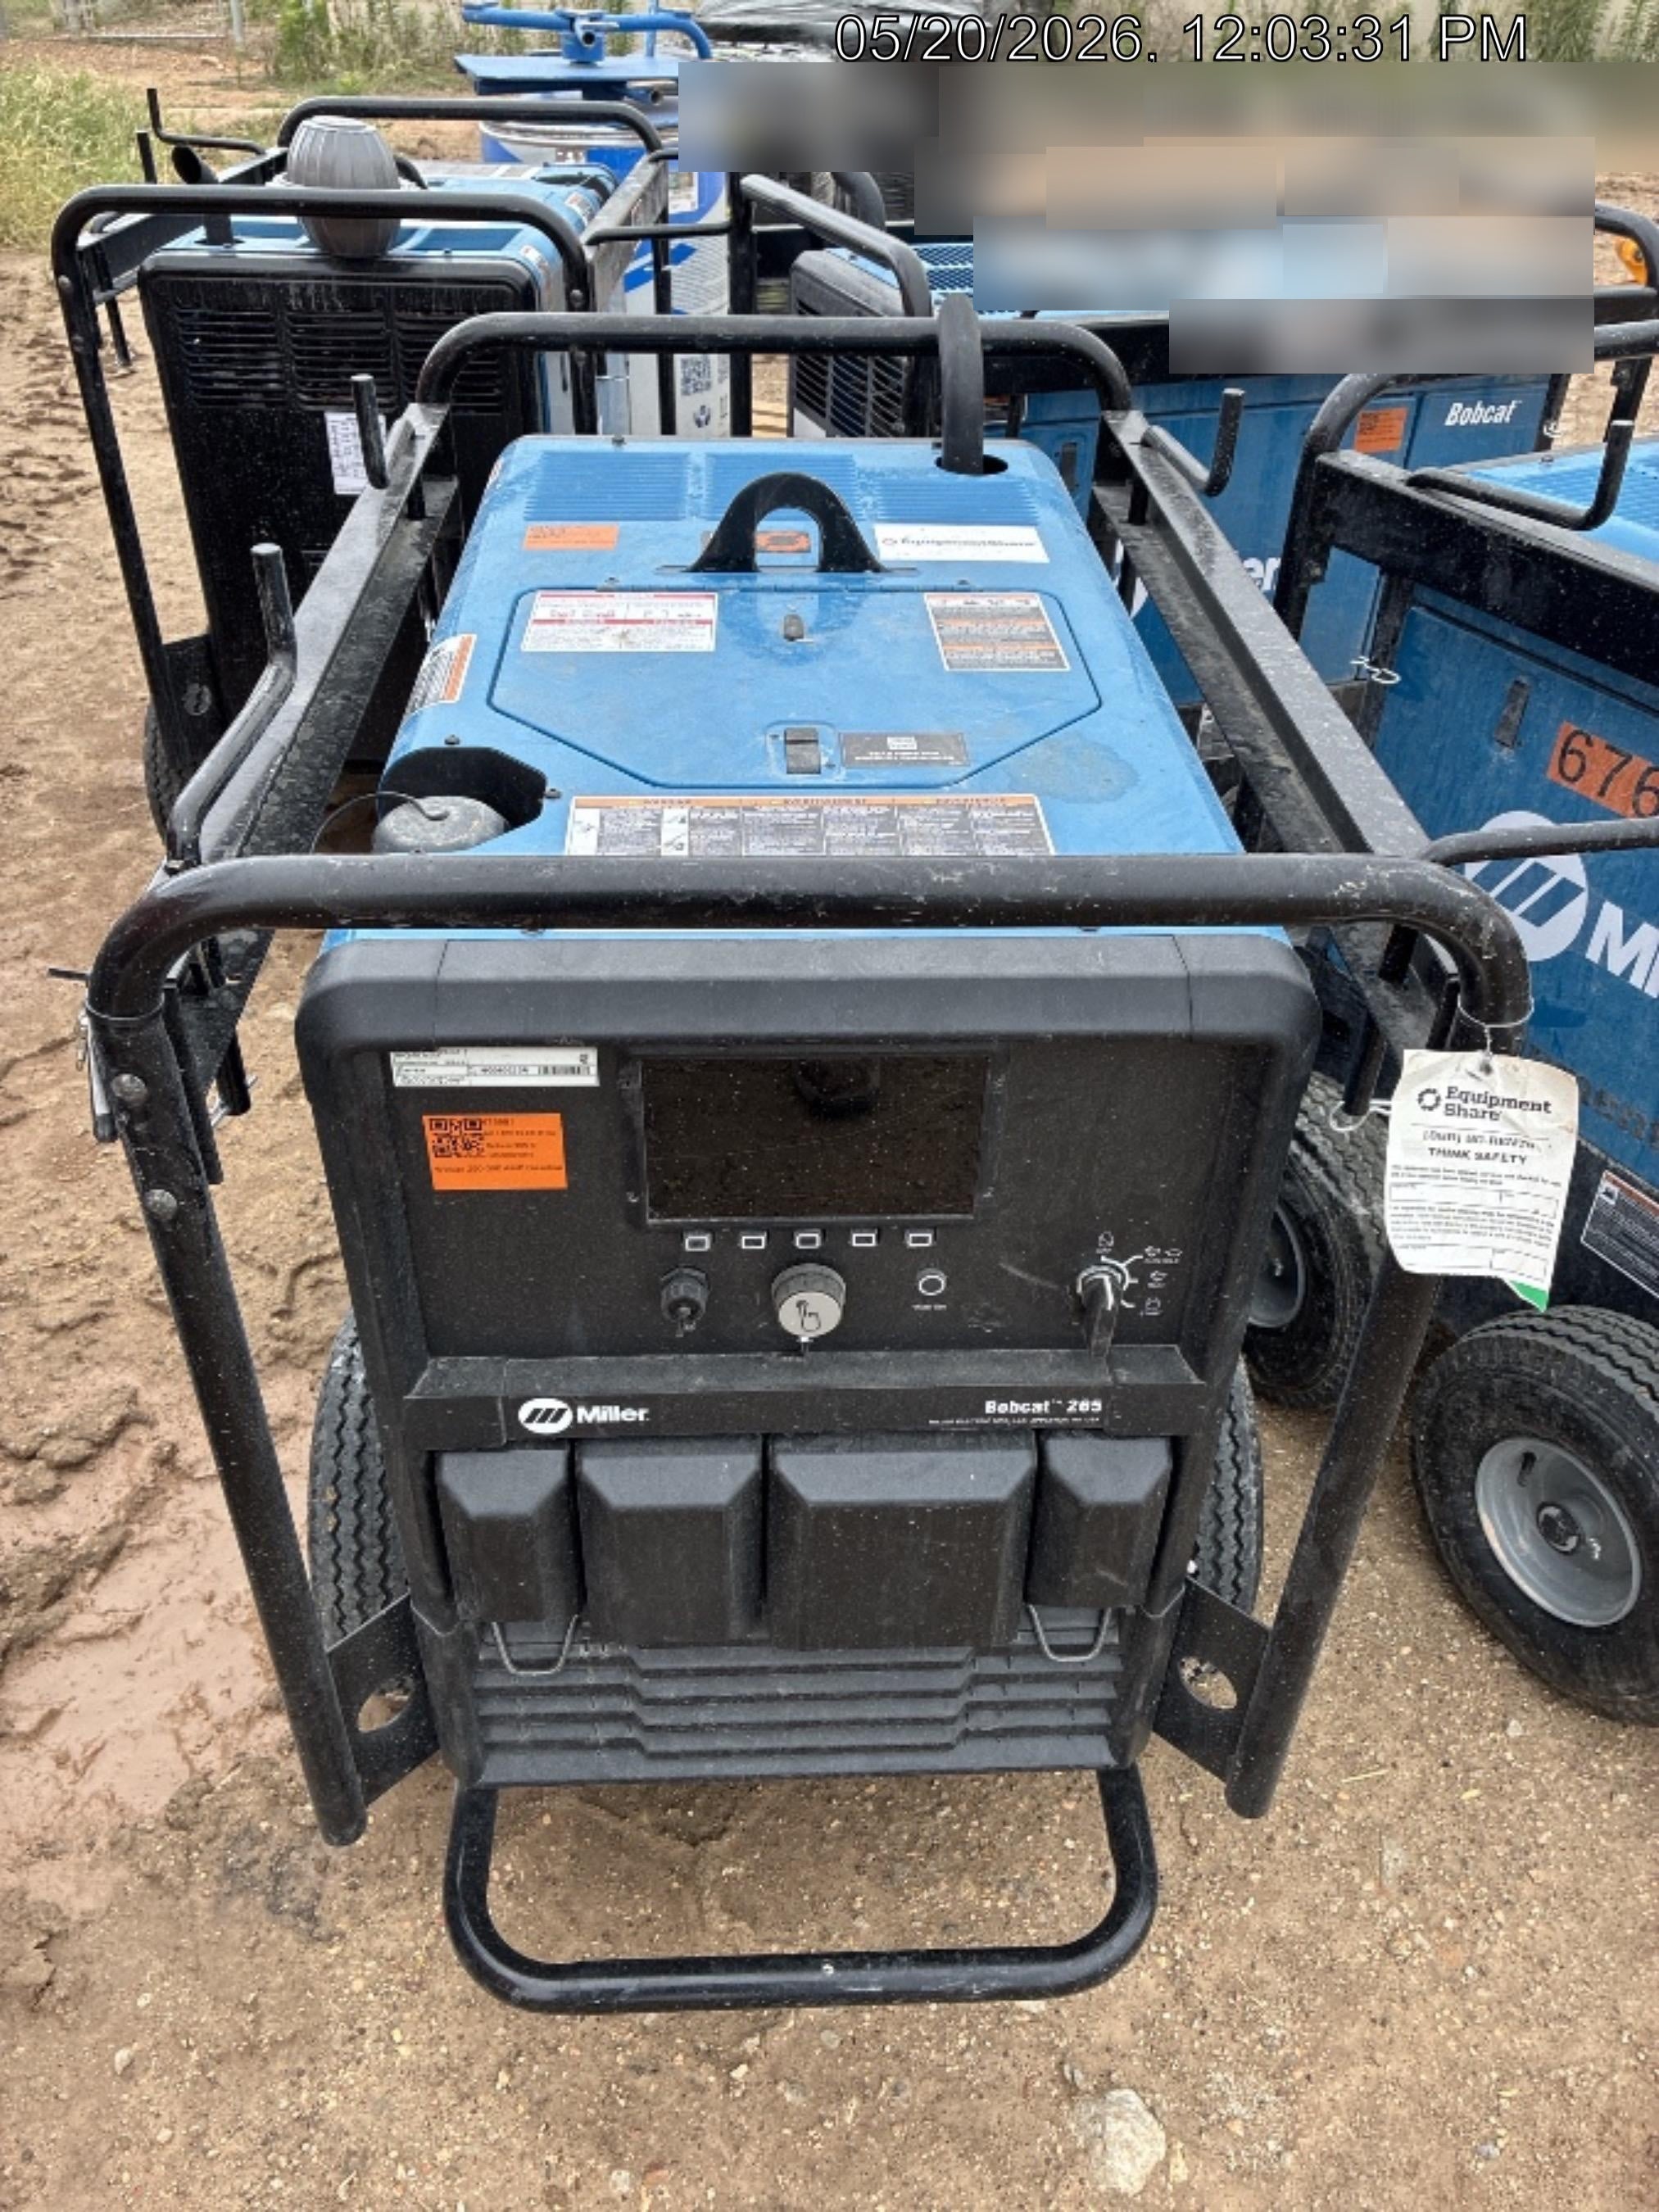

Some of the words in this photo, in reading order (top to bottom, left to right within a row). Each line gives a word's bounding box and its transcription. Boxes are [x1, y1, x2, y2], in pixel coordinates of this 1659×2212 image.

[1445, 1086, 1552, 1113] Equipment
[1444, 1103, 1501, 1122] Share
[577, 1405, 650, 1424] Miller
